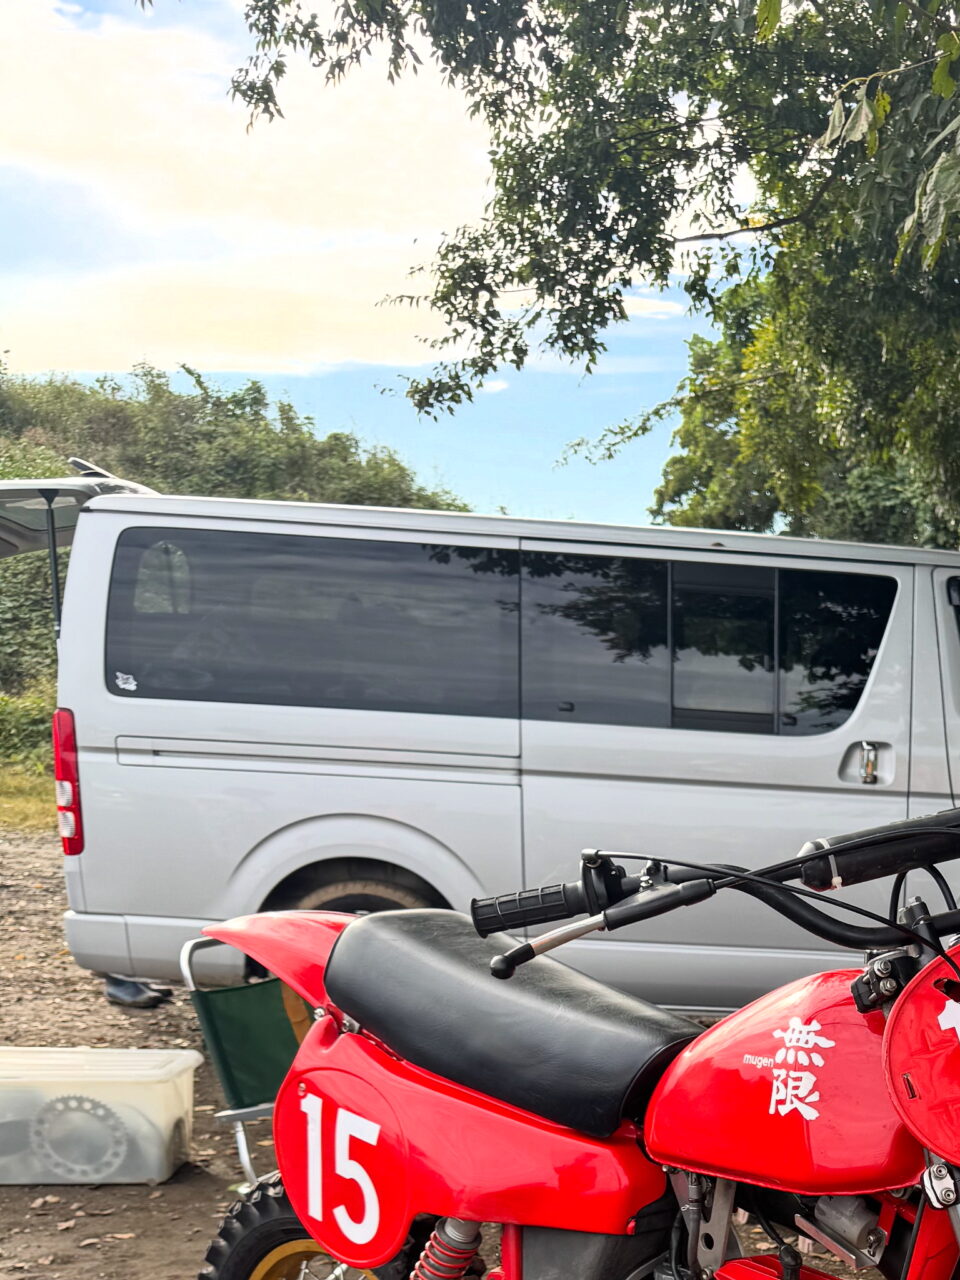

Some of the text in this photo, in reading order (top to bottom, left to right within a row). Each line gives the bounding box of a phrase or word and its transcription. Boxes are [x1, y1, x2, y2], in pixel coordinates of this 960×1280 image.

[743, 1054, 774, 1069] mugen
[768, 1016, 836, 1121] 無限
[301, 1093, 381, 1245] 15
